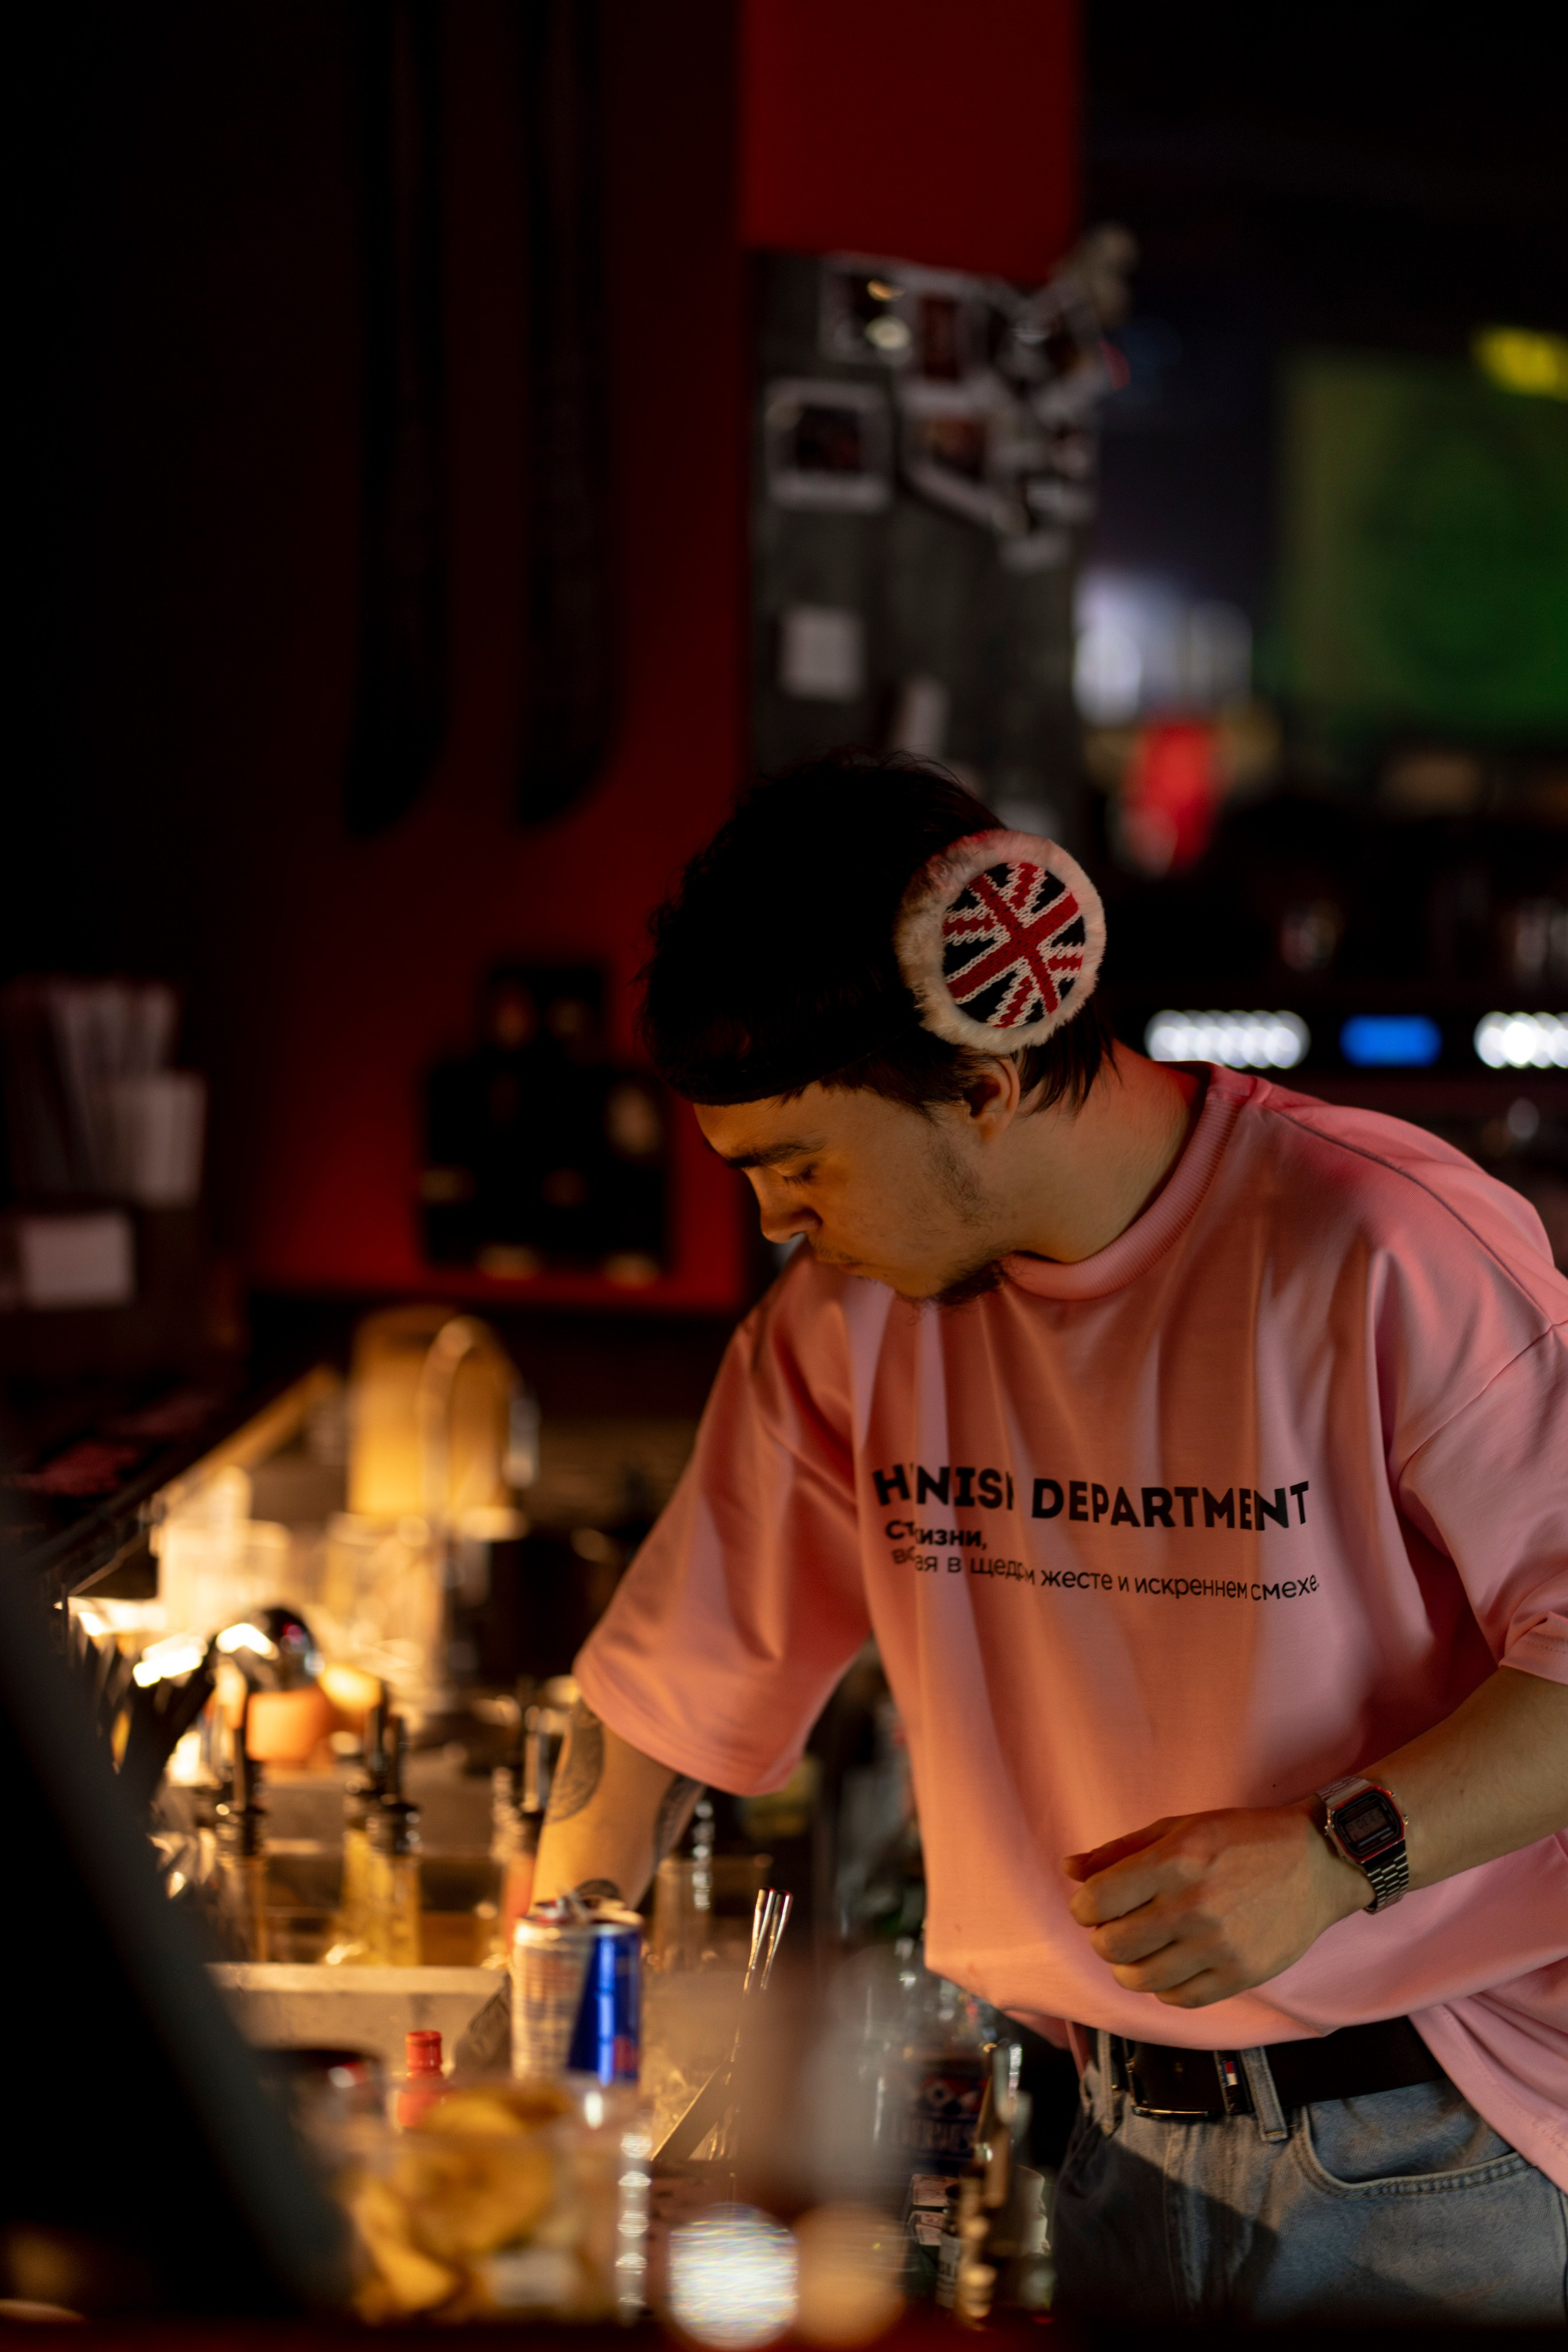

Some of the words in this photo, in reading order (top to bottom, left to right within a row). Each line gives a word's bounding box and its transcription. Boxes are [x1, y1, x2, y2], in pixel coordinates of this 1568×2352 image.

[1031, 1478, 1310, 1531] DEPARTMENT
[947, 1556, 962, 1573] в
[1041, 1570, 1113, 1591] жесте
[1118, 1575, 1129, 1592] и
[1134, 1576, 1248, 1599] искреннем
